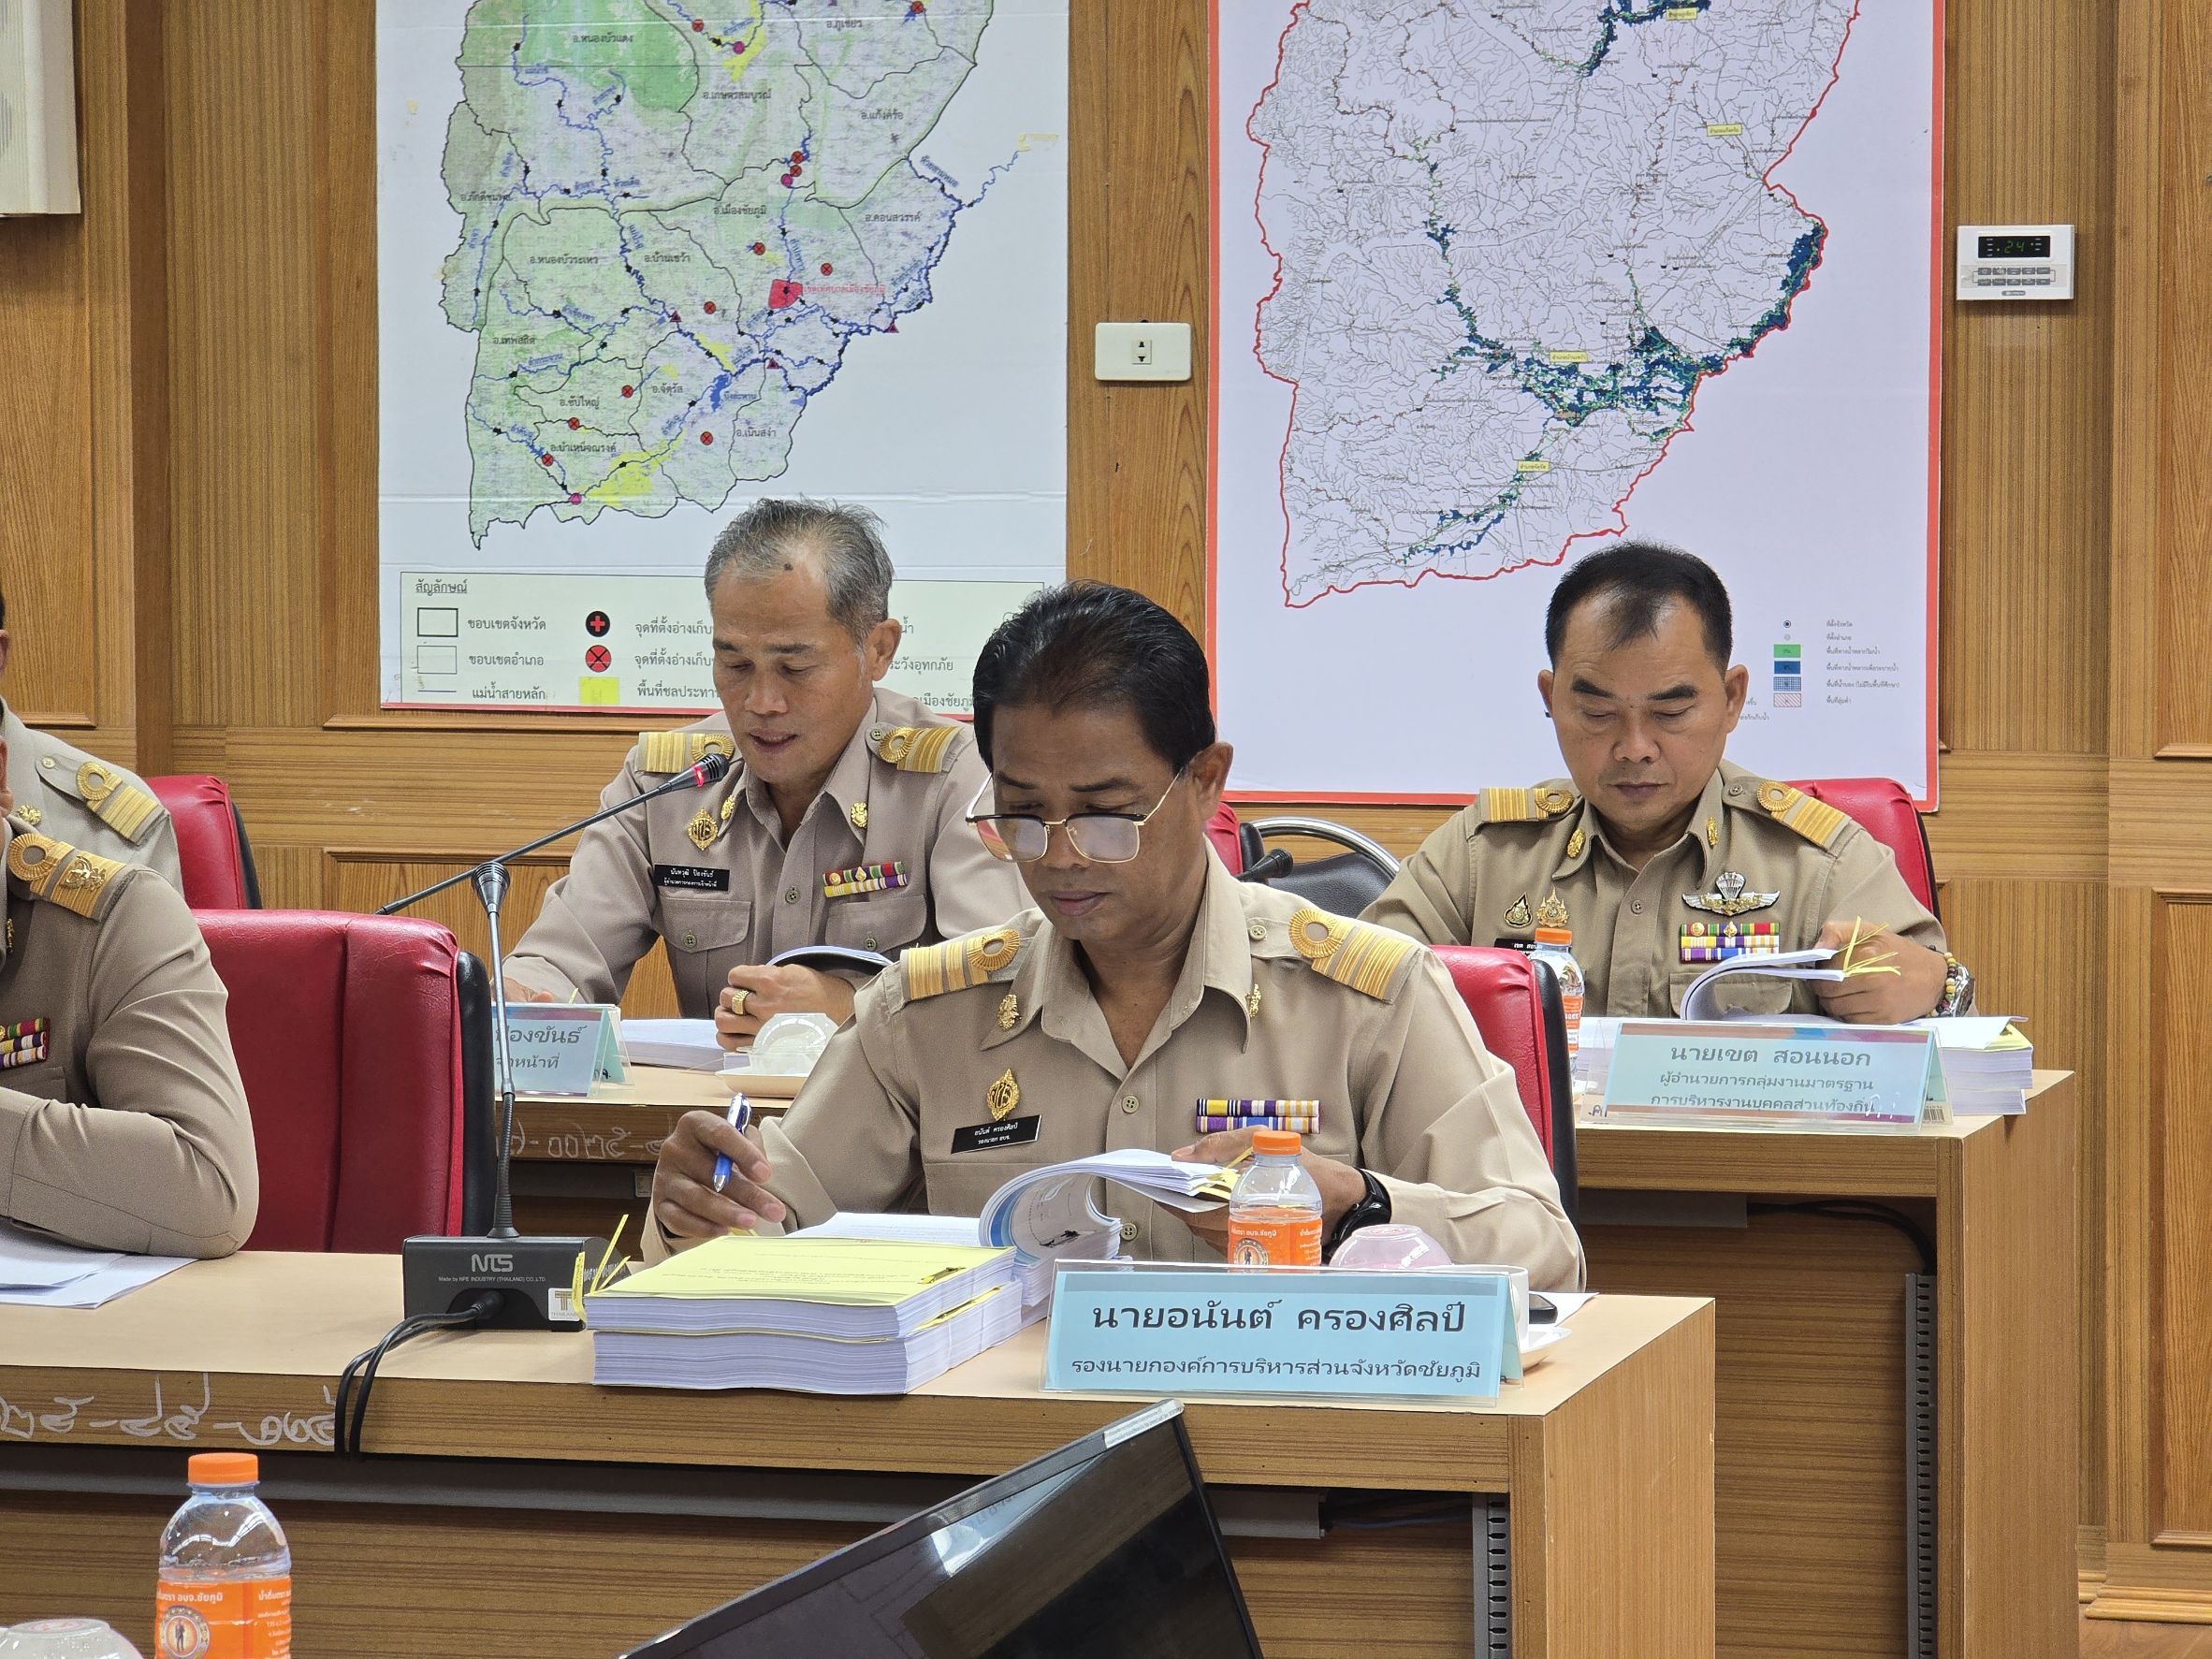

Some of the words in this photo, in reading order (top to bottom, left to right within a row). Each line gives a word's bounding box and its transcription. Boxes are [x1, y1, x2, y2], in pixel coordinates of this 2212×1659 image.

[2003, 240, 2026, 255] 24
[415, 578, 468, 596] สัญลักษณ์
[467, 614, 546, 631] ขอบเขตจังหวัด
[469, 653, 545, 667] ขอบเขตอำเภอ
[634, 647, 714, 668] จุดที่ตั้งอ่างเก็บ
[473, 680, 546, 700] แม่น้ำสายหลัก
[1670, 1044, 1759, 1064] นายเขต
[1773, 1048, 1871, 1067] สอนนอก
[1659, 1071, 1874, 1091] ผู้อำนวยการกลุ่มงานมาตรฐาน
[1092, 1299, 1281, 1331] นายอนันต์
[1297, 1301, 1466, 1333] ครองศิลป์
[1071, 1354, 1482, 1383] รองนายกองค์การบริหารส่วนจังหวัดชัยภูมิ
